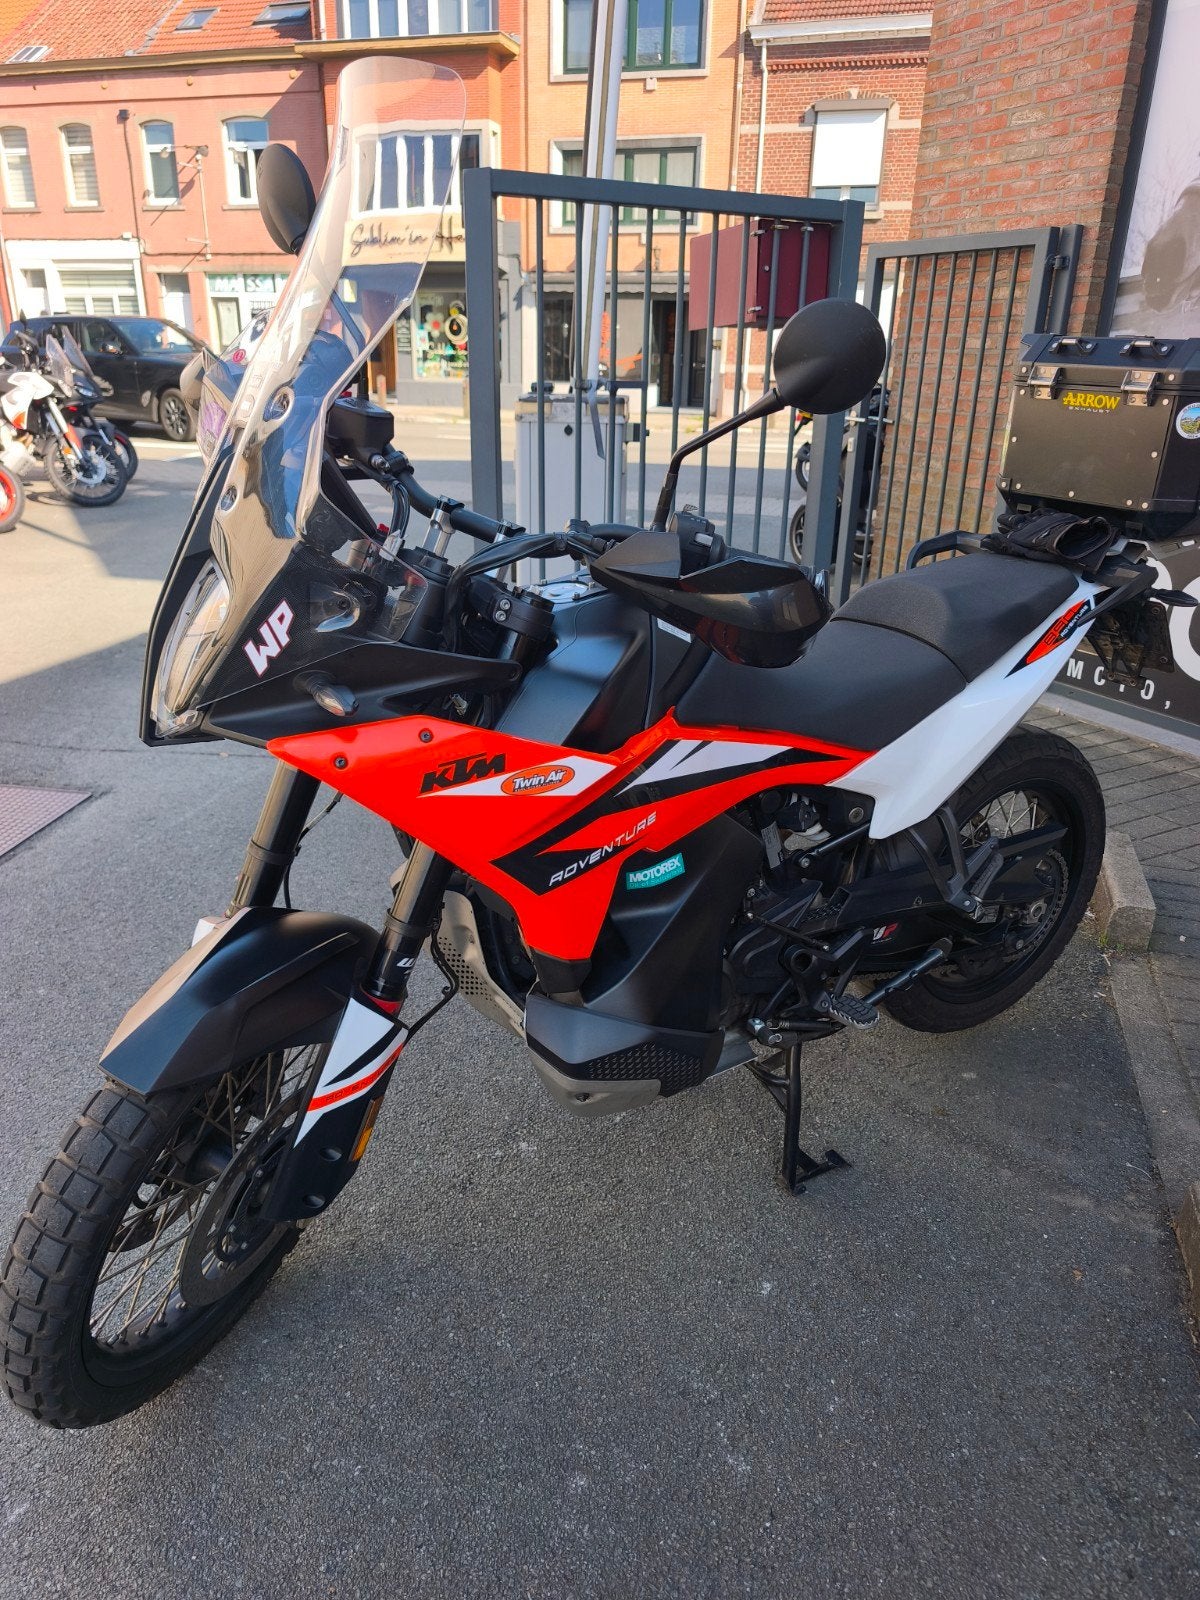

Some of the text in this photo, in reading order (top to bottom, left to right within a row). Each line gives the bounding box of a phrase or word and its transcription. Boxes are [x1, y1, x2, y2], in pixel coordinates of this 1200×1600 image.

[1062, 391, 1120, 410] ARROW
[243, 599, 294, 677] WP
[420, 752, 507, 794] KTM
[512, 773, 544, 791] Twin
[544, 768, 566, 785] Air
[548, 811, 657, 887] ADVENTURE
[629, 856, 682, 882] MOTOREX
